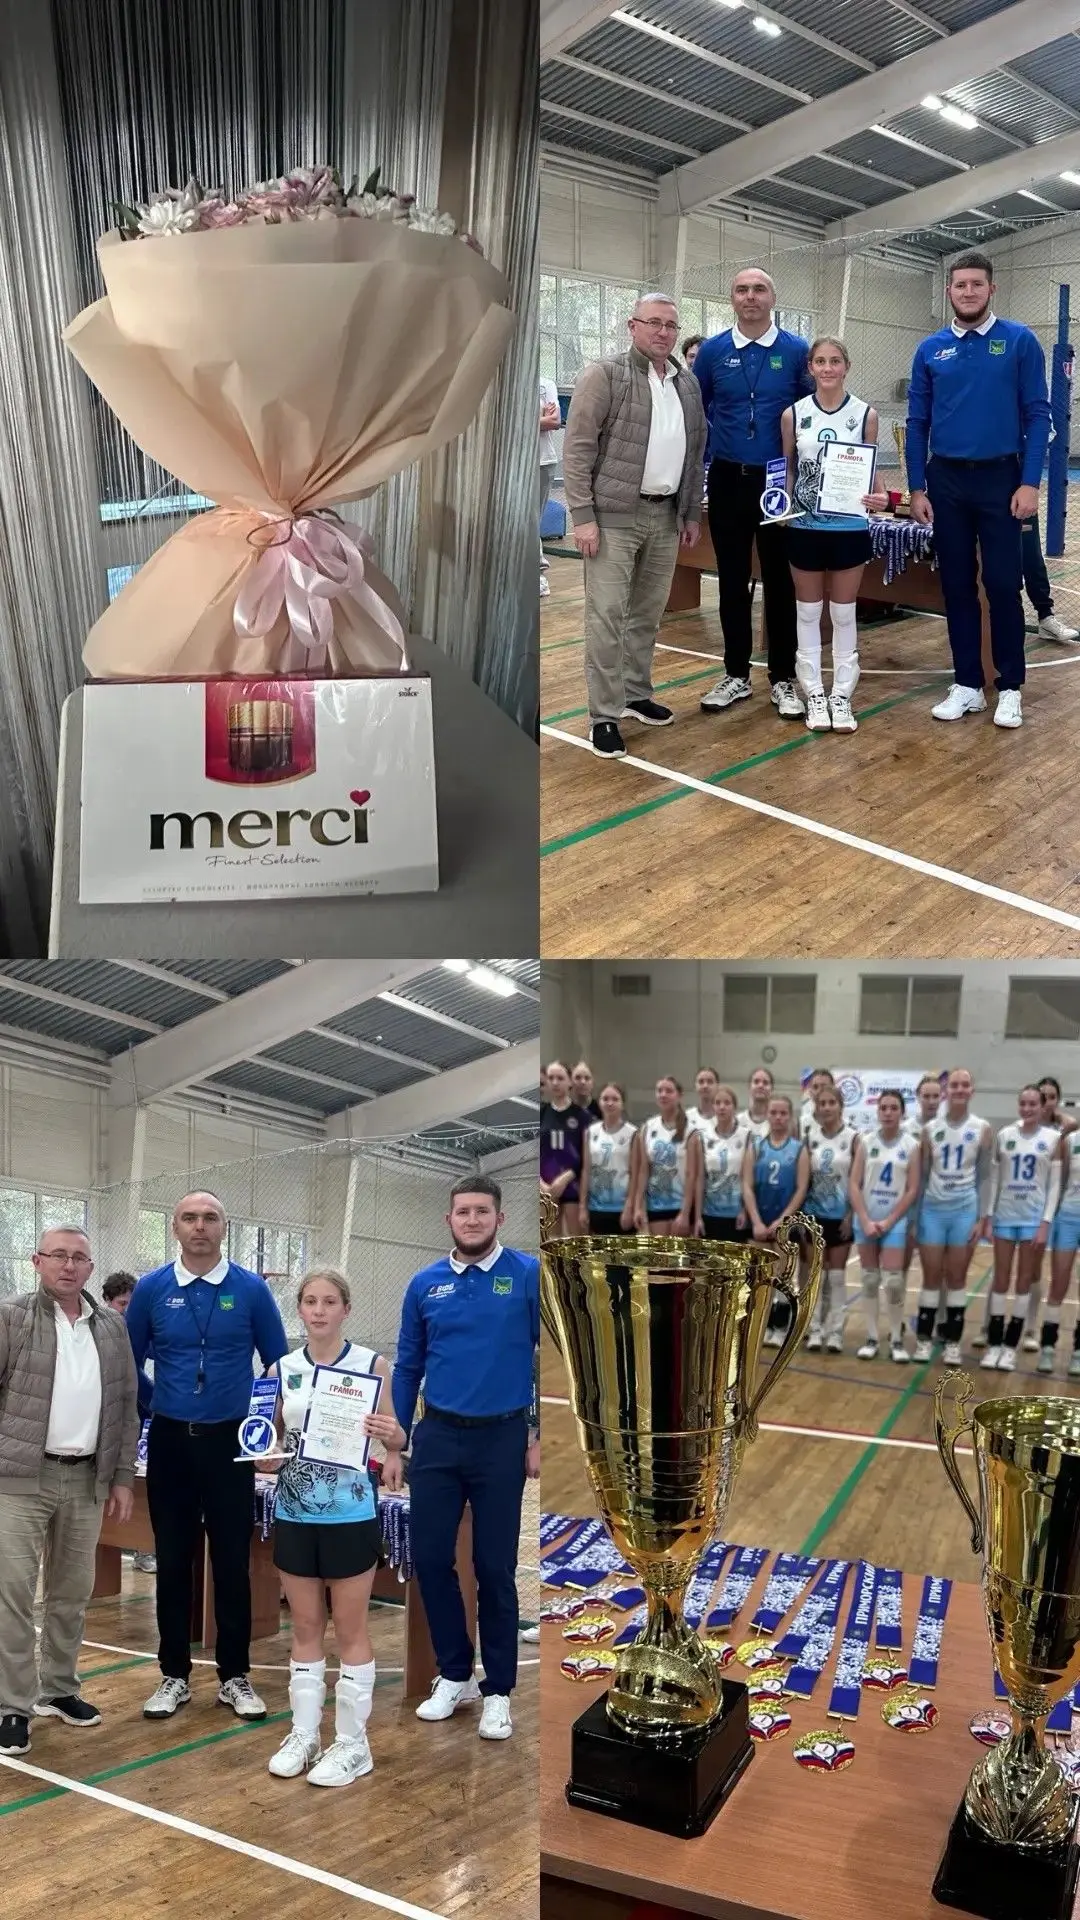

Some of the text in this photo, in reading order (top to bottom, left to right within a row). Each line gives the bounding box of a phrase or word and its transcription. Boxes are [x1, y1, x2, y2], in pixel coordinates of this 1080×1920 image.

[837, 454, 864, 462] ГРАМОТА
[149, 789, 370, 851] merci
[205, 852, 321, 868] Finest Selection
[820, 1147, 834, 1174] 2
[941, 1144, 964, 1171] 11
[1010, 1153, 1037, 1181] 13
[768, 1160, 781, 1185] 2
[879, 1161, 893, 1187] 4
[329, 1384, 363, 1399] ГРАМОТА
